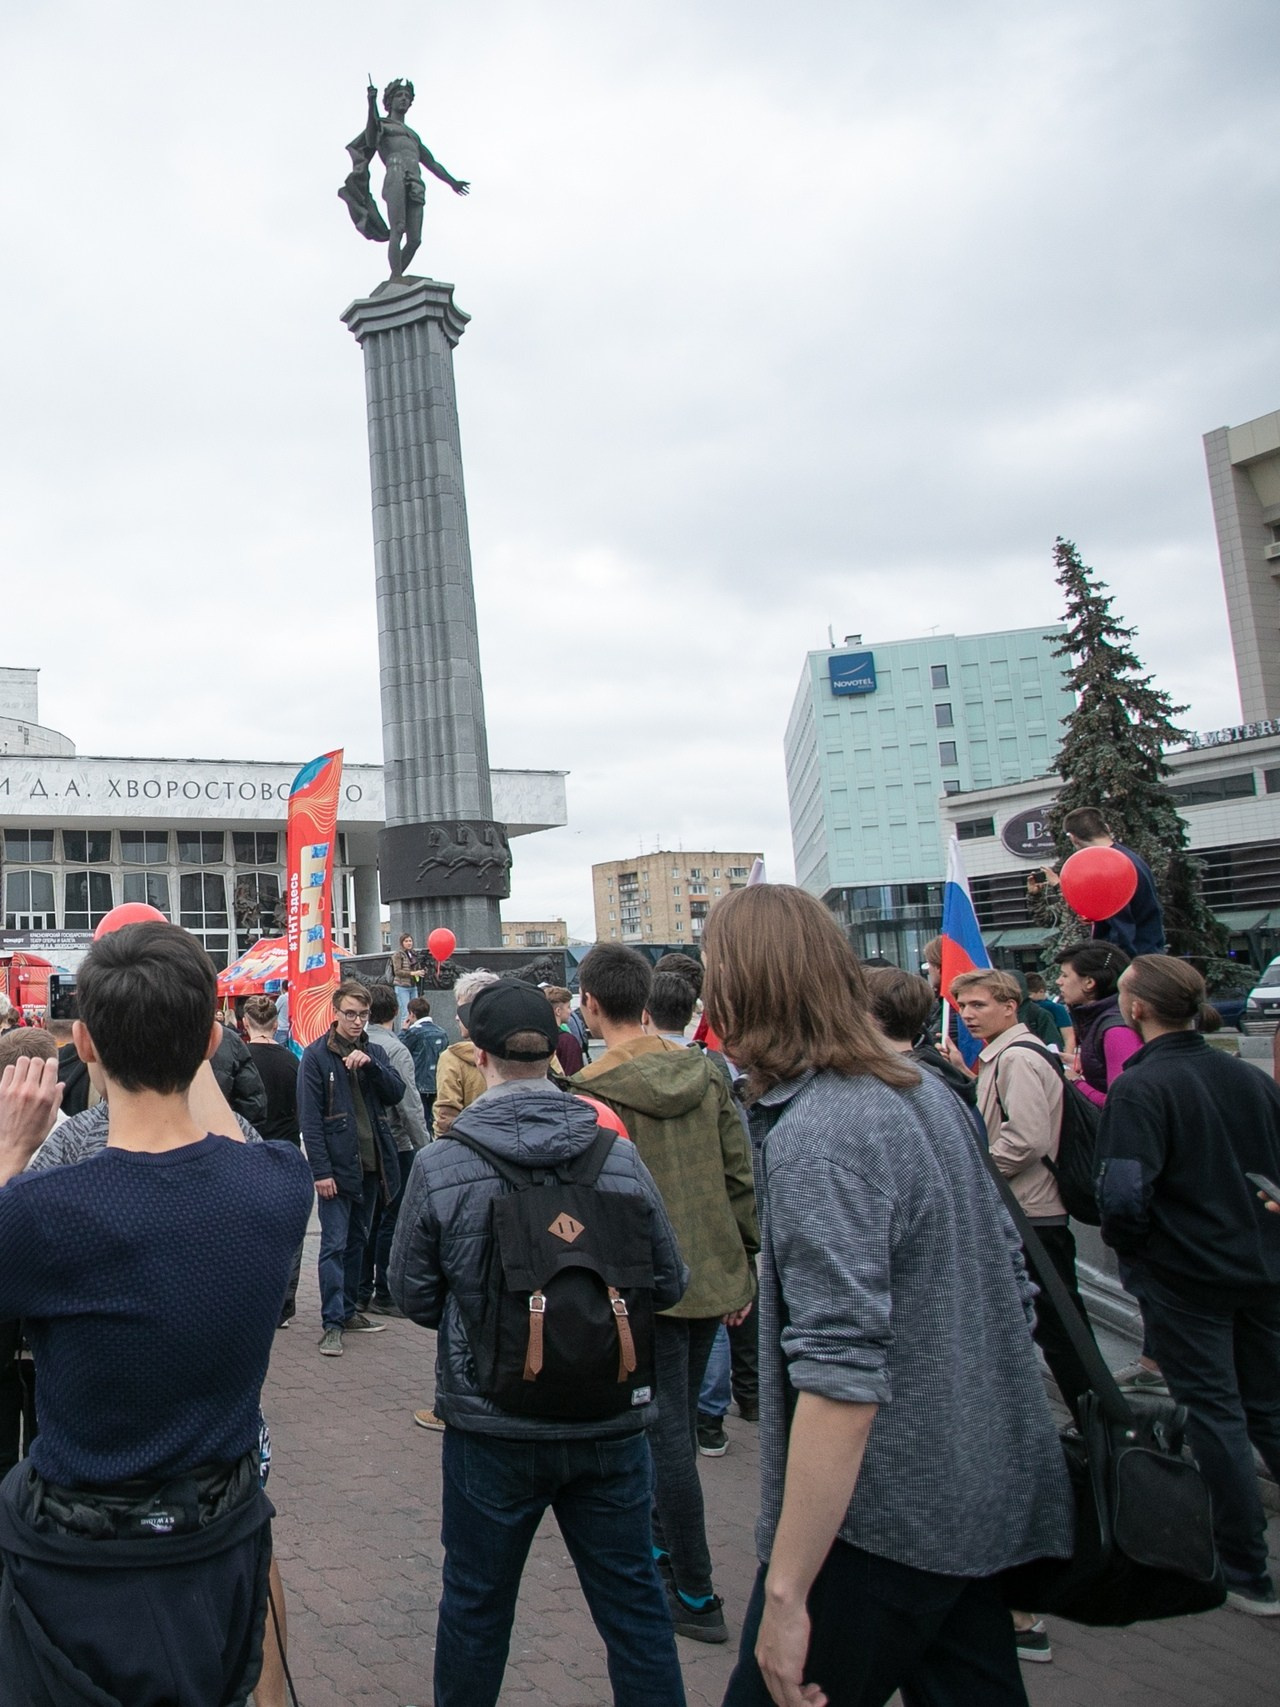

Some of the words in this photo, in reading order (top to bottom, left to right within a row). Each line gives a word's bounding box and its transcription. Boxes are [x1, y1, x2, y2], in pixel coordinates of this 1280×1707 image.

[833, 678, 873, 688] NOVOTEL
[1190, 718, 1280, 749] AMSTER
[29, 778, 91, 799] Д.А.
[107, 779, 363, 803] ХВОРОСТОВСО
[288, 872, 299, 952] #ТНТздесь
